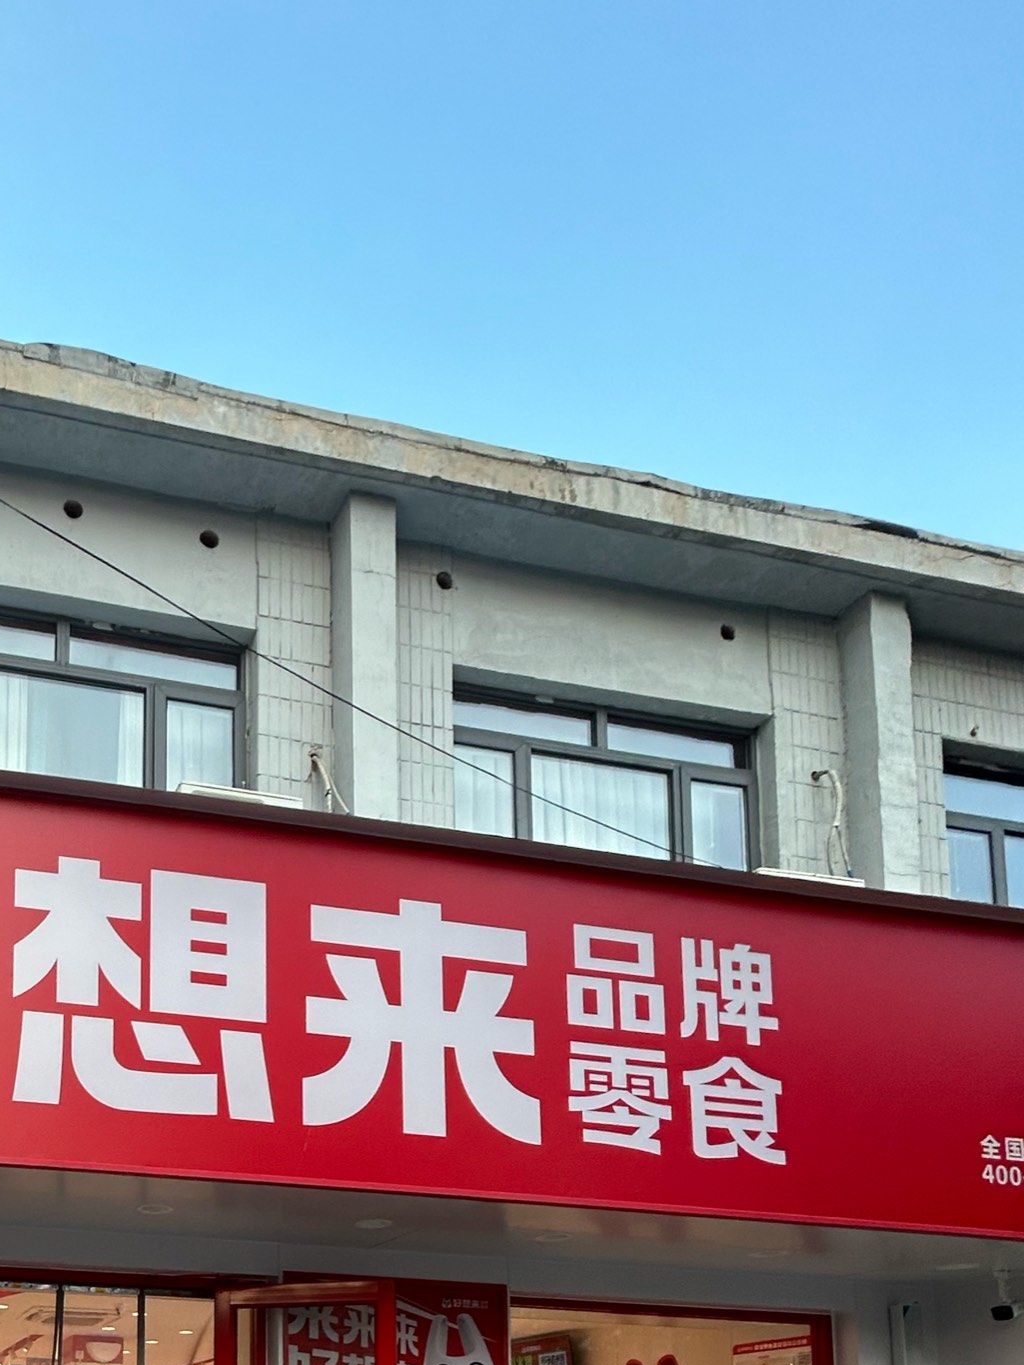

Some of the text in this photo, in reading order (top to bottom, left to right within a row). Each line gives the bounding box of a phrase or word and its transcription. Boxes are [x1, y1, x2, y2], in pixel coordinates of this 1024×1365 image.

[566, 923, 779, 1047] 品牌
[567, 1040, 787, 1167] 零食
[979, 1134, 1024, 1162] 全国
[981, 1163, 1022, 1187] 400
